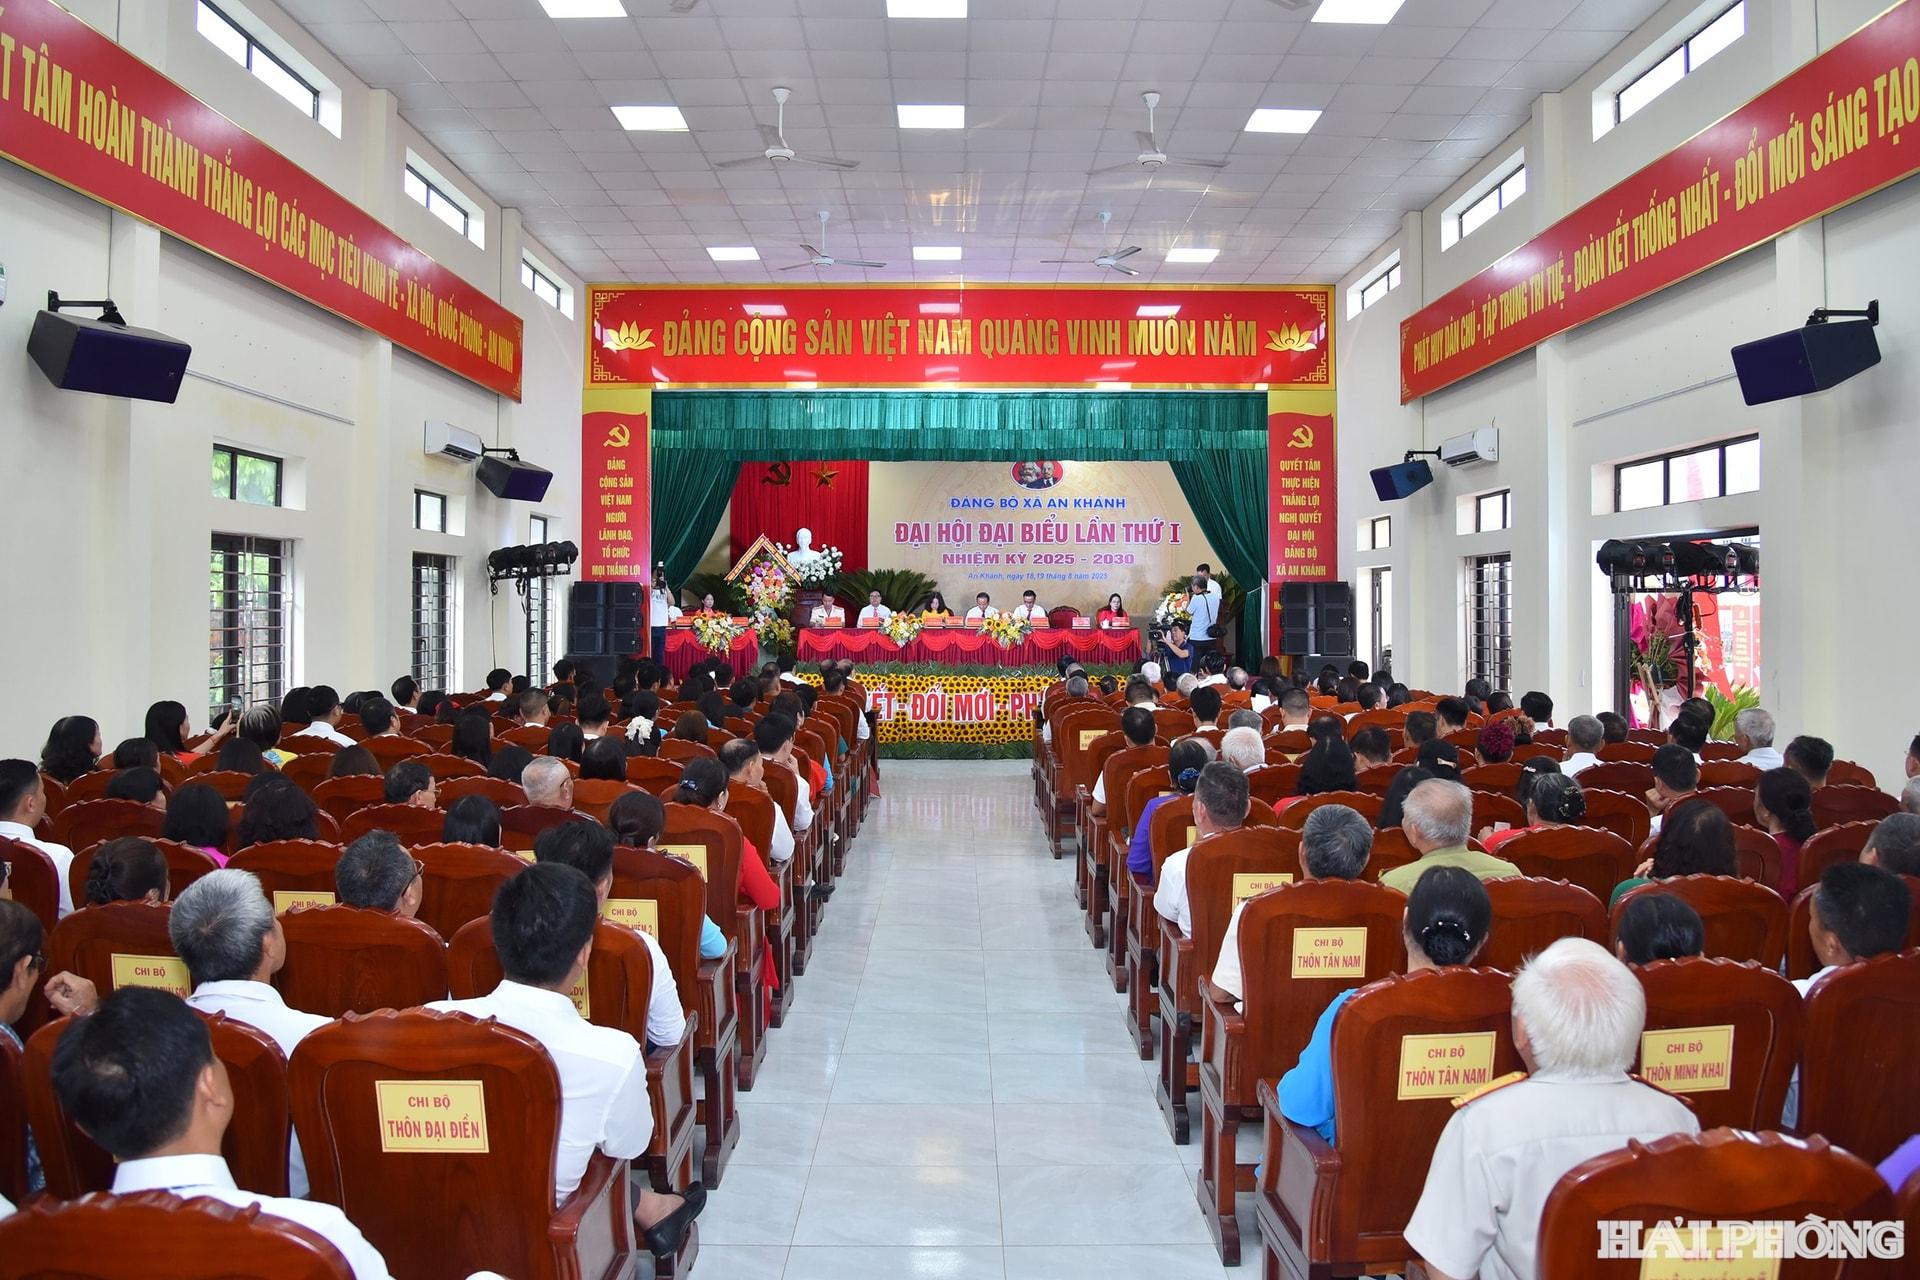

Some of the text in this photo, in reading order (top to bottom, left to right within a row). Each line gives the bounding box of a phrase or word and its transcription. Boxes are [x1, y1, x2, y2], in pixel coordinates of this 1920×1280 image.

[22, 42, 72, 134] TÂM
[78, 80, 136, 168] HOÀN
[141, 119, 199, 201] THÀNH
[203, 148, 253, 230] THẮNG
[256, 186, 278, 251] LỢI
[281, 198, 306, 259] CÁC
[309, 219, 335, 281] MỤC
[338, 234, 361, 289] TIÊU
[362, 251, 386, 304] KINH
[406, 276, 418, 321] XÃ
[438, 294, 458, 340] QUỐC
[459, 309, 483, 358] PHÒNG
[487, 330, 497, 365] AN
[498, 335, 514, 373] NINH
[1413, 331, 1431, 374] PHÁT
[1430, 327, 1444, 367] HUY
[1444, 316, 1459, 359] DÂN
[1461, 300, 1476, 351] CHỦ
[1482, 293, 1498, 345] TẬP
[1499, 280, 1528, 331] TRUNG
[1547, 251, 1565, 310] TUỆ
[1574, 233, 1605, 293] ĐOÀN
[1607, 209, 1630, 276] KẾT
[1632, 189, 1677, 263] THỐNG
[1680, 157, 1720, 239] NHẤT
[1735, 127, 1764, 211] ĐỔI
[1768, 112, 1805, 194] MỚI
[1810, 91, 1869, 171] SÁNG
[1873, 57, 1920, 145] TẠO
[663, 309, 1257, 362] ĐẢNG CỘNG SẢN VIỆT NAM QUANG VINH MUÔN NĂM
[607, 457, 626, 470] ĐẢNG
[1280, 457, 1320, 472] QUYẾT TÂM
[600, 475, 633, 490] CỘNG SẢN
[1281, 476, 1319, 491] THỰC HIỆN
[600, 493, 632, 507] VIỆT NAM
[951, 496, 1126, 510] ĐẢNG BỘ XÃ AN KHÁNH
[1282, 492, 1319, 509] THẮNG LỢI
[1279, 511, 1321, 526] NGHỊ QUYẾT
[599, 528, 616, 541] LÃNH
[895, 513, 1180, 547] ĐẠI HỘI ĐẠI BIỂU LẦN THỨ I
[1287, 529, 1314, 543] ĐẠI HỘI
[612, 546, 630, 558] CHỨC
[942, 552, 999, 566] NHIỆM
[1005, 551, 1027, 564] KỲ
[1033, 553, 1075, 564] 2025
[1093, 553, 1135, 564] 2030
[1285, 546, 1317, 560] ĐẢNG BỘ
[592, 562, 640, 578] MỌI THẮNG LỢI
[968, 572, 978, 580] An
[1006, 572, 1023, 581] ngày
[1046, 572, 1066, 581] tháng
[1091, 572, 1108, 580] 2025
[1276, 563, 1326, 576] XÃ AN KHÁNH
[871, 683, 896, 720] ẾT
[912, 683, 947, 720] ĐỔI
[955, 688, 994, 720] MỚI
[627, 908, 637, 917] BỘ
[1314, 937, 1344, 948] CHI BỘ
[1298, 952, 1360, 968] THÔN TÂN NAM
[135, 966, 166, 978] CHI BỘ
[1428, 1045, 1465, 1059] CHI BỘ
[1666, 1040, 1703, 1054] CHI BỘ
[1406, 1065, 1487, 1086] THÔN TÂN NAM
[1645, 1062, 1724, 1082] THÔN MINH KHAI
[408, 1094, 450, 1110] CHI BỘ
[388, 1113, 480, 1142] THÔN ĐẠI ĐIỀN
